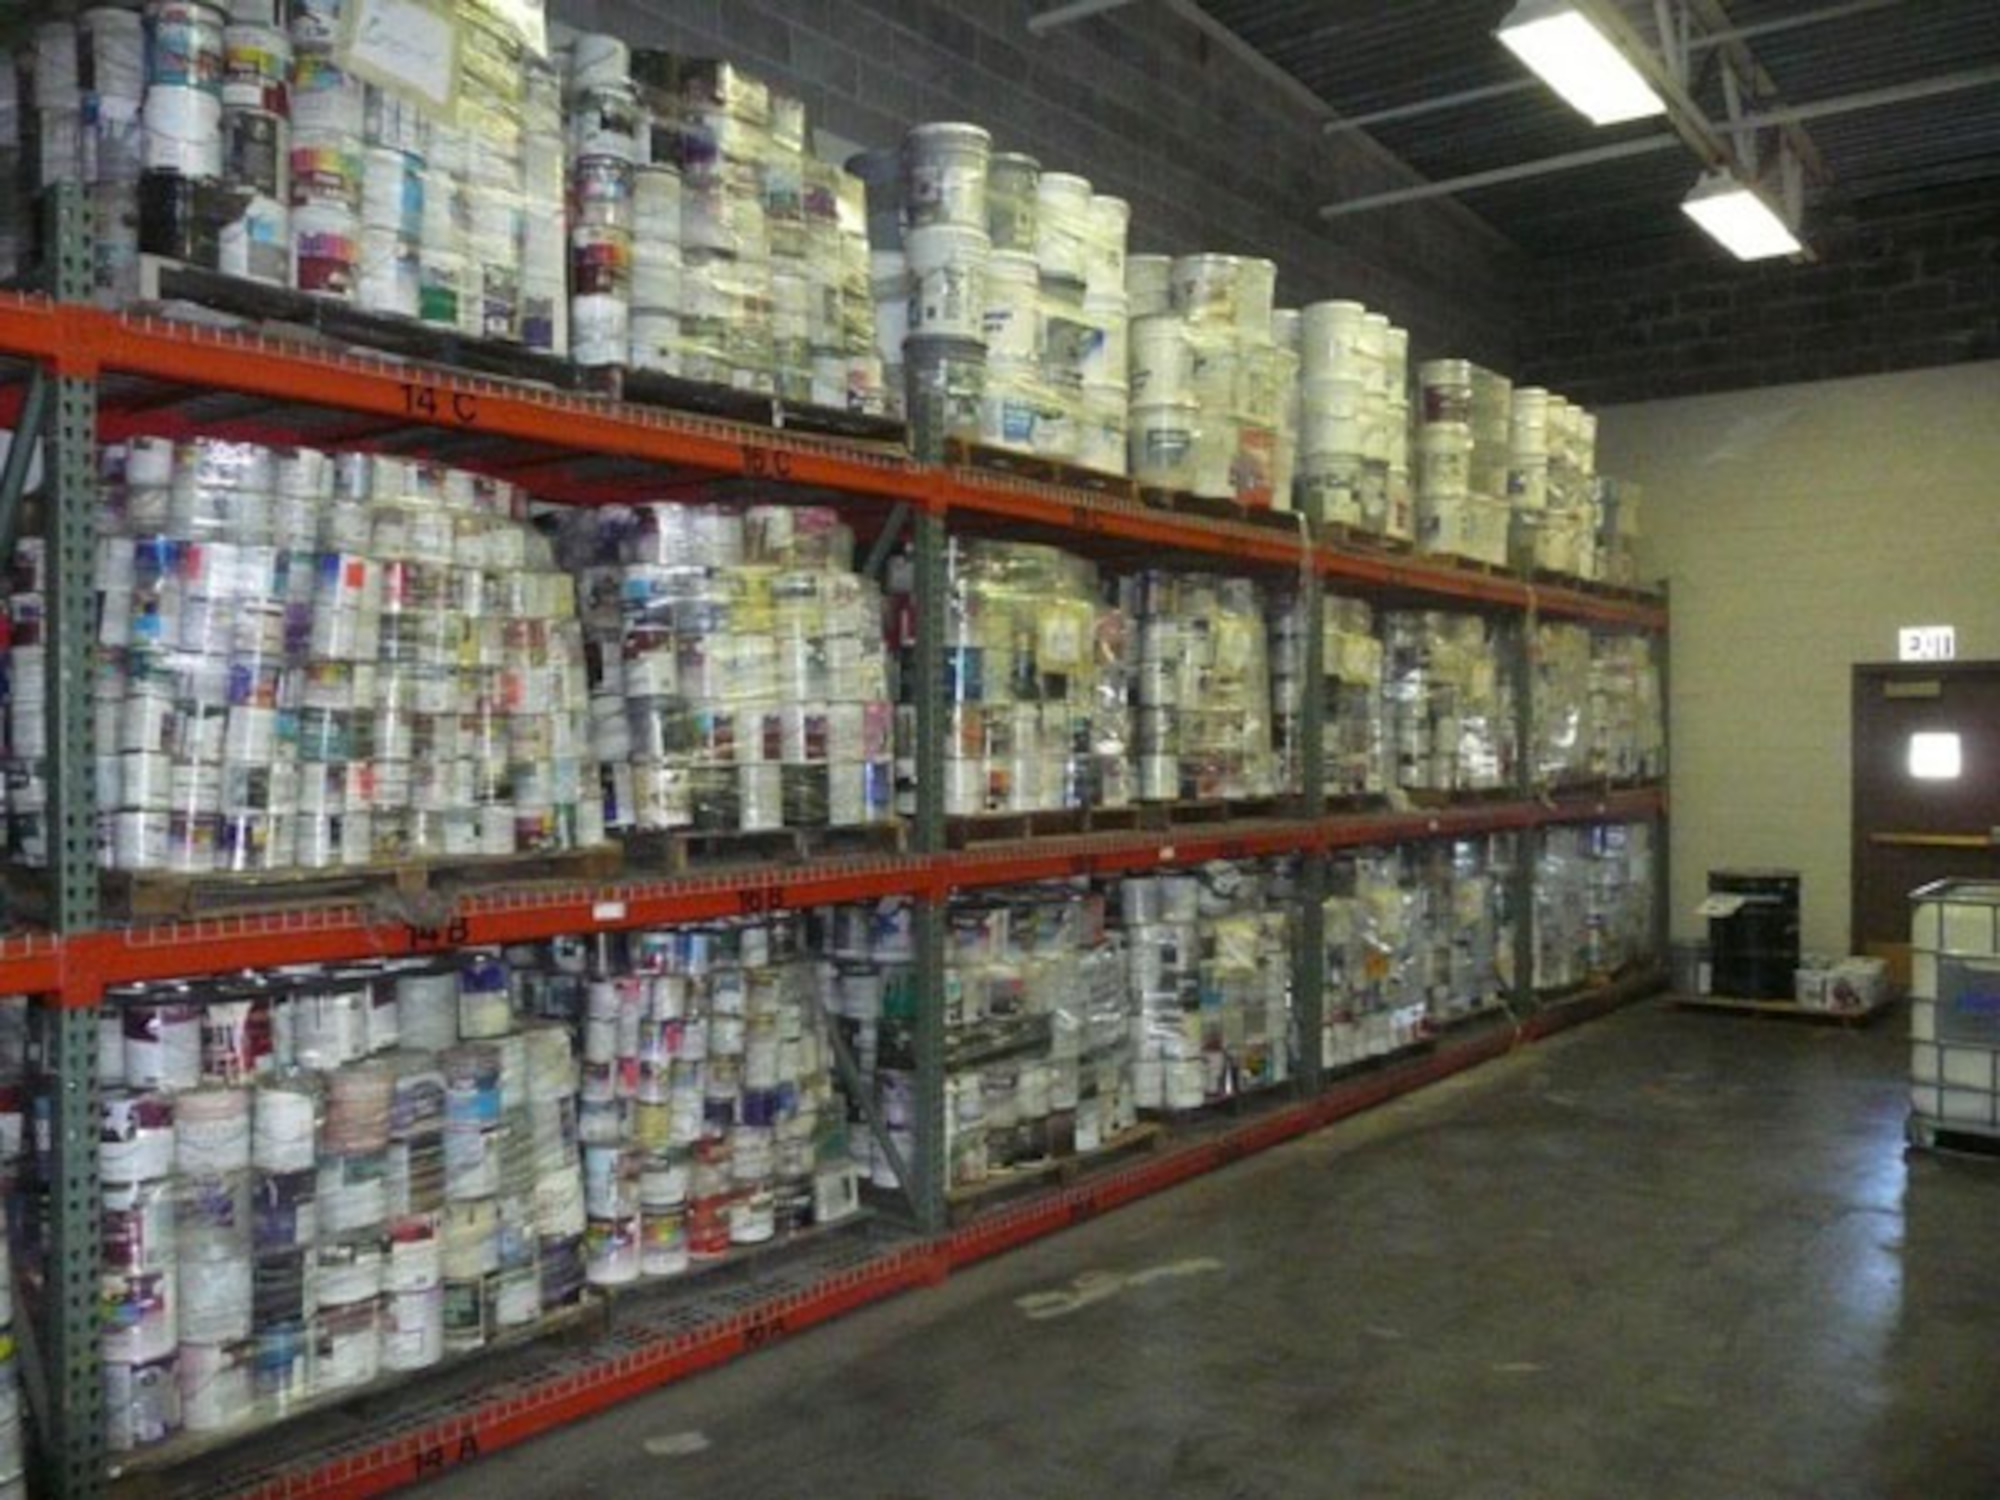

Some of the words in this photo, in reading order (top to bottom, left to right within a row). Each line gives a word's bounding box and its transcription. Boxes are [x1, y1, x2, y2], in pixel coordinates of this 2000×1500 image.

[400, 384, 436, 416] 14
[454, 393, 476, 421] C
[449, 917, 467, 943] B
[459, 1436, 478, 1462] A
